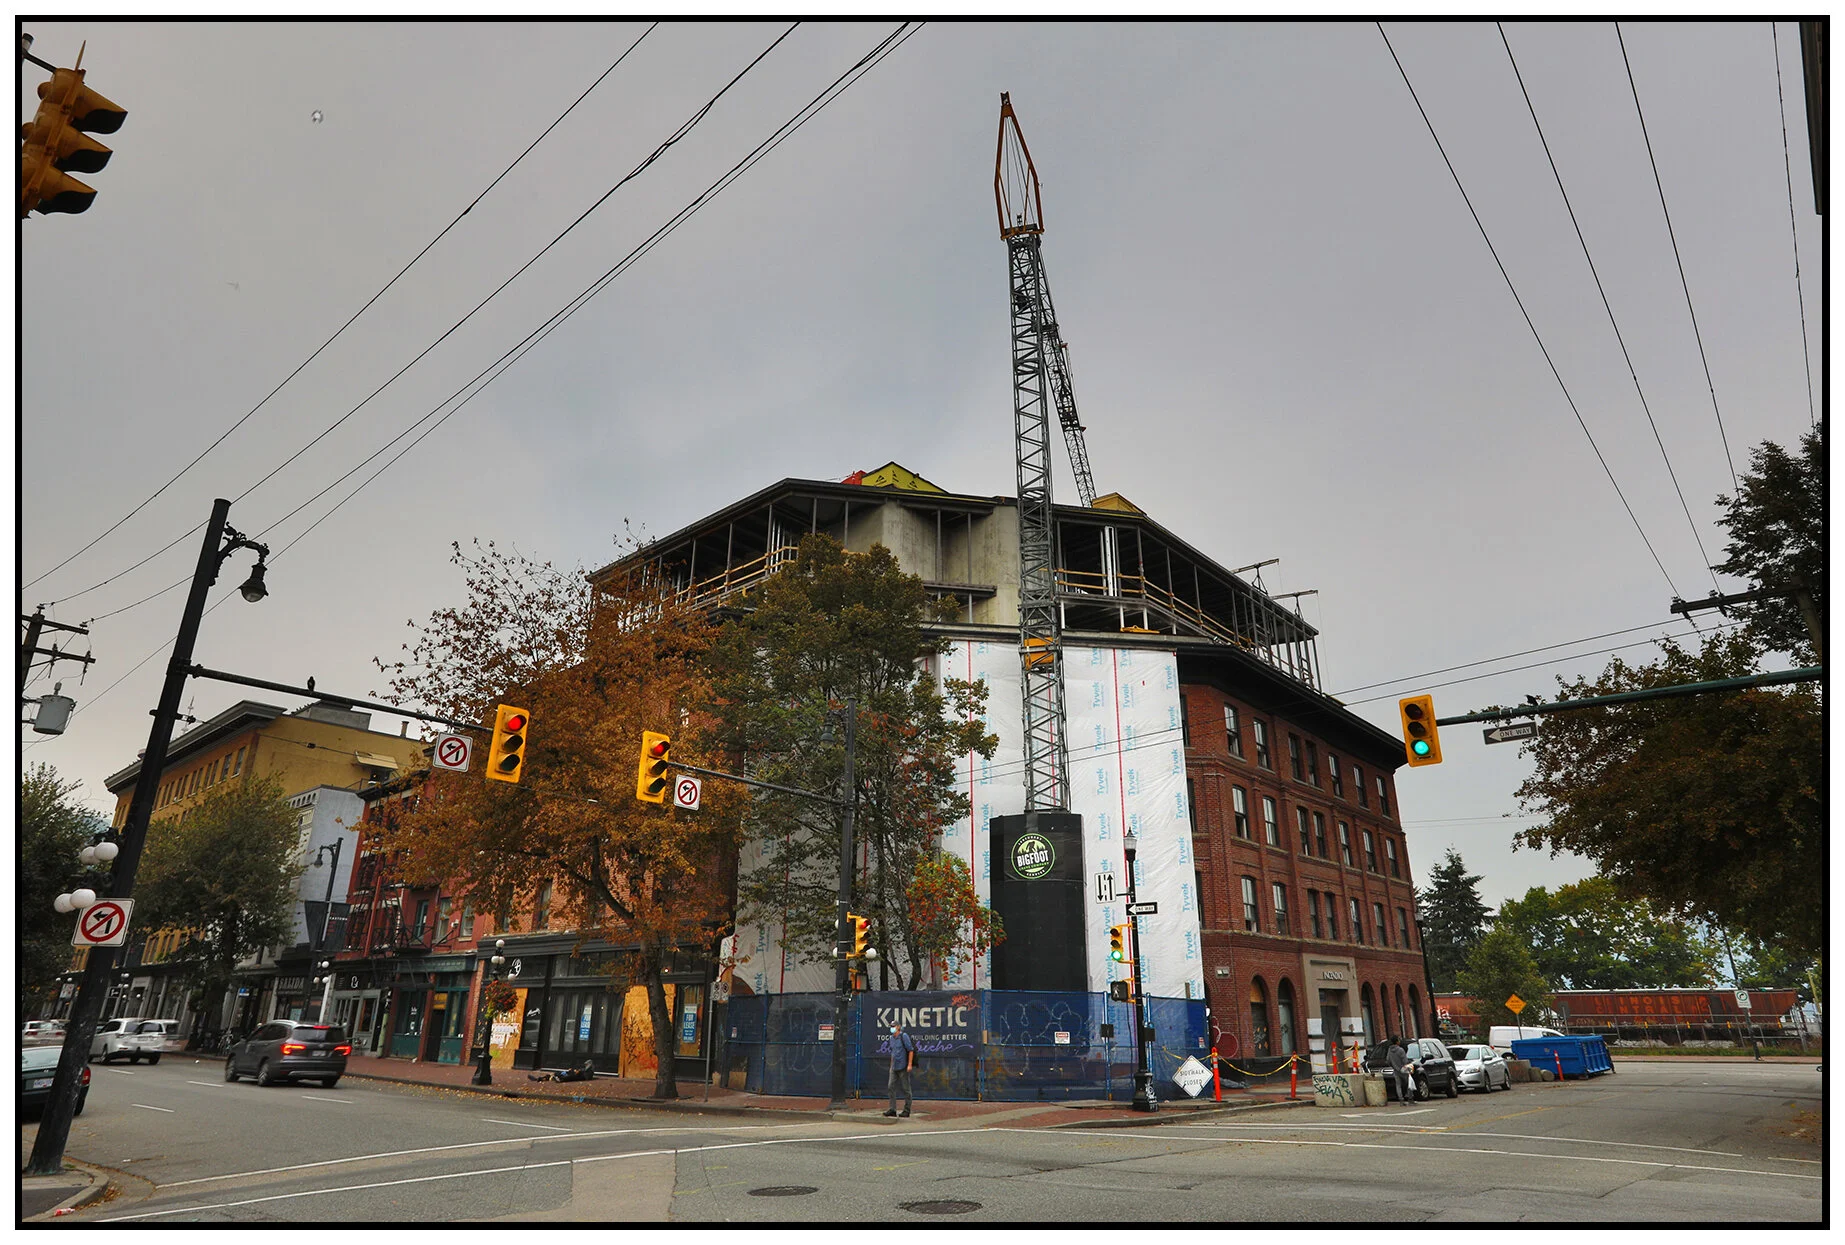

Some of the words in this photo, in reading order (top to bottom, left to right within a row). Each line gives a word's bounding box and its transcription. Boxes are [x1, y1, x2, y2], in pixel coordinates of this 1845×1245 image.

[1165, 665, 1173, 690] Tyvek
[1093, 682, 1101, 708] Tyvek
[1121, 684, 1129, 709] Tyvek
[1516, 727, 1530, 735] WAY
[1172, 748, 1181, 775] Tyvek
[1096, 768, 1105, 795] Tyvek
[1127, 769, 1136, 796] Tyvek
[981, 803, 990, 833] Tyvek
[1175, 792, 1184, 819] Tyvek
[1098, 813, 1108, 840] Tyvek
[1017, 850, 1049, 867] BIGFOOT
[1178, 836, 1188, 865] Tyvek
[1182, 883, 1192, 912] Tyvek
[1185, 931, 1194, 961] Tyvek
[877, 1006, 967, 1028] KINETIC
[1180, 1069, 1205, 1077] SIDEWALK
